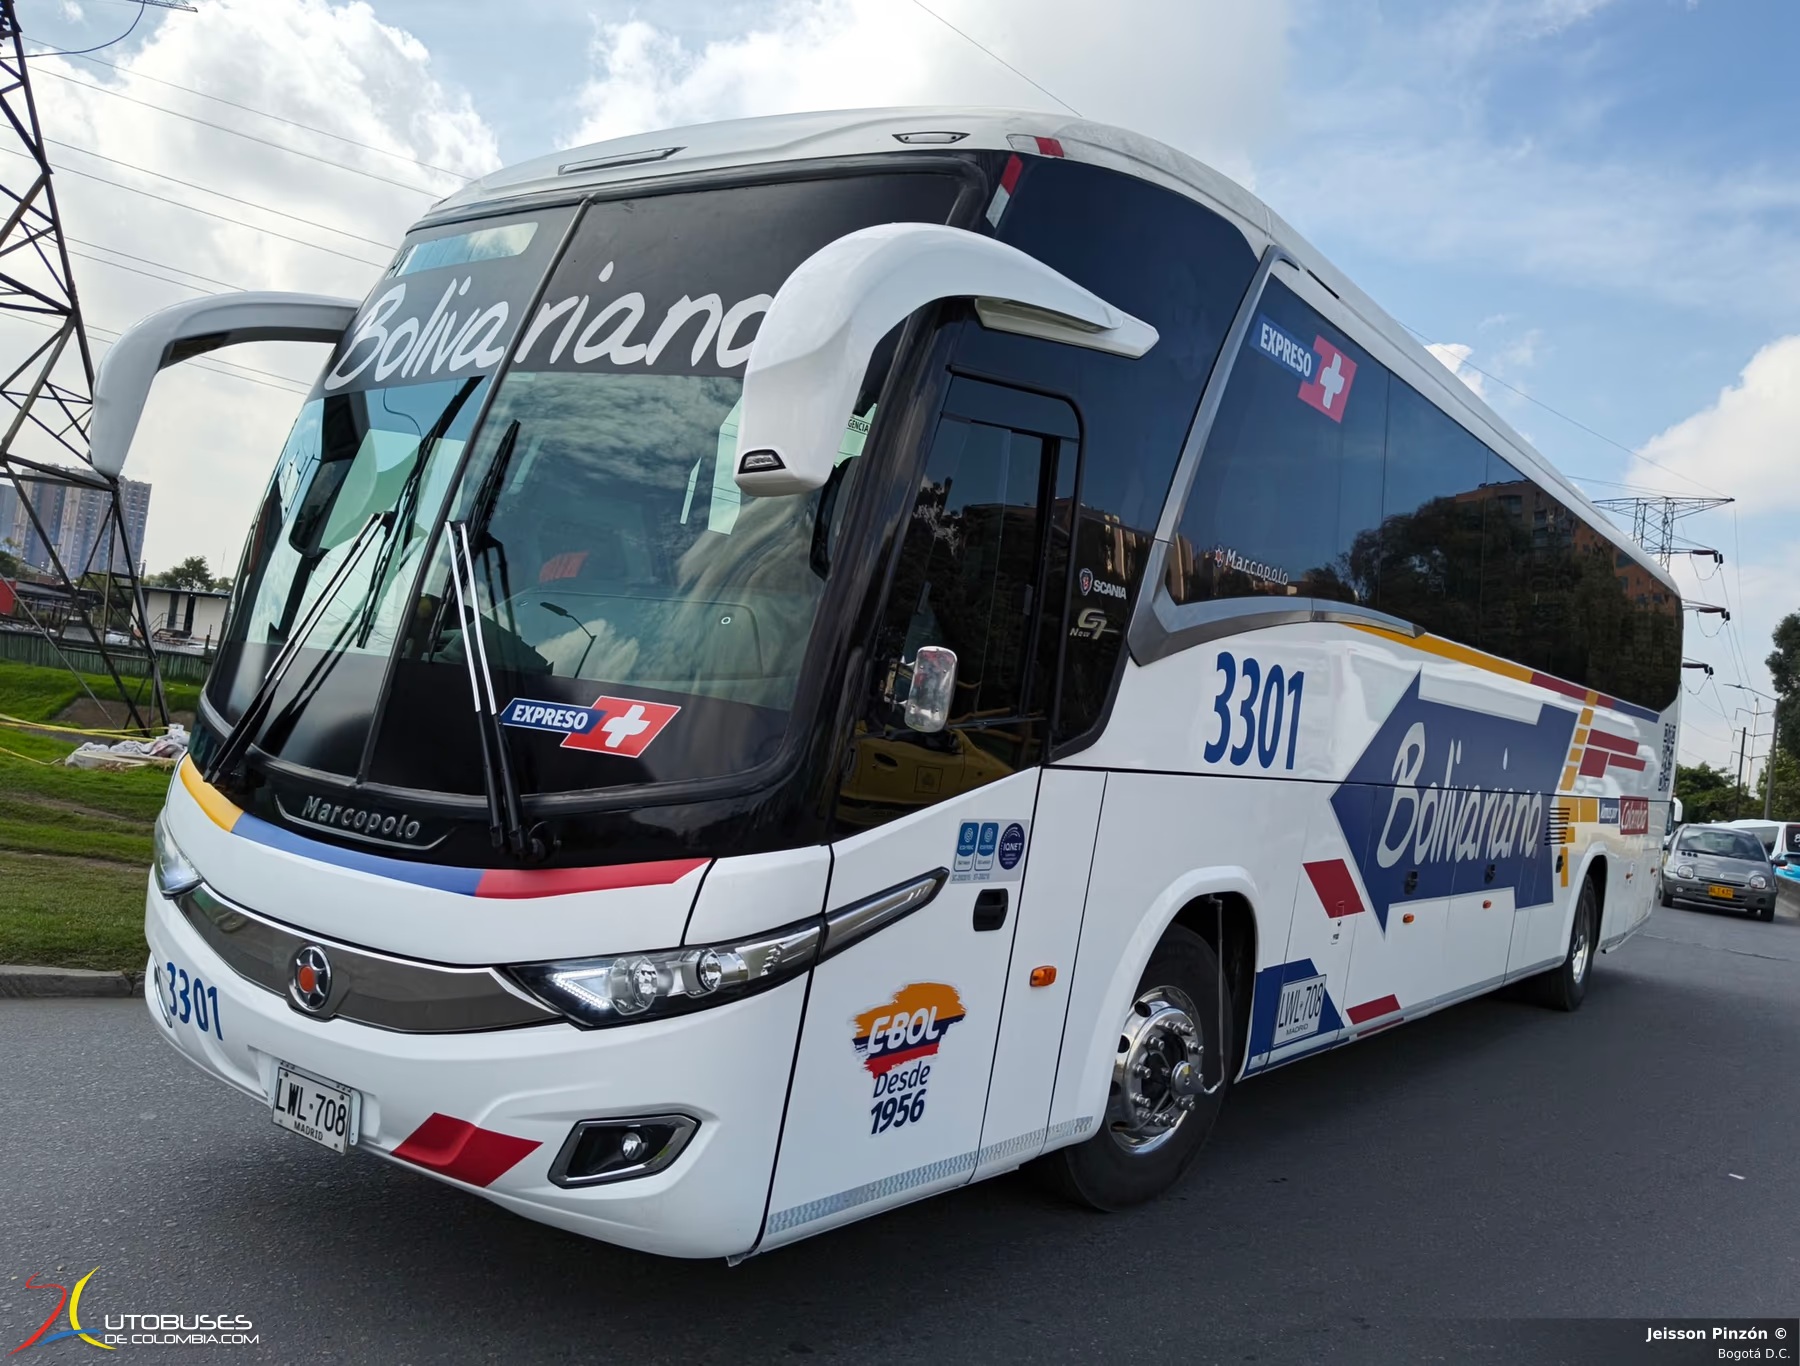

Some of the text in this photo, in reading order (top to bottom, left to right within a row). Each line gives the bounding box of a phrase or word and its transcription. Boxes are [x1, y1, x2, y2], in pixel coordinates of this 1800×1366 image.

[1259, 322, 1313, 378] EXPRESO
[1225, 548, 1289, 586] Marcopolo
[1093, 579, 1127, 600] SCANIA
[511, 704, 589, 730] EXPRESO
[1203, 651, 1305, 770] 3301
[1377, 722, 1543, 868] Bolivariano
[301, 795, 422, 840] Marcopolo
[166, 961, 224, 1042] 3301
[1286, 1023, 1309, 1035] MADRID
[873, 1060, 931, 1099] Desde
[293, 1121, 324, 1141] MADRID
[870, 1088, 927, 1135] 1956
